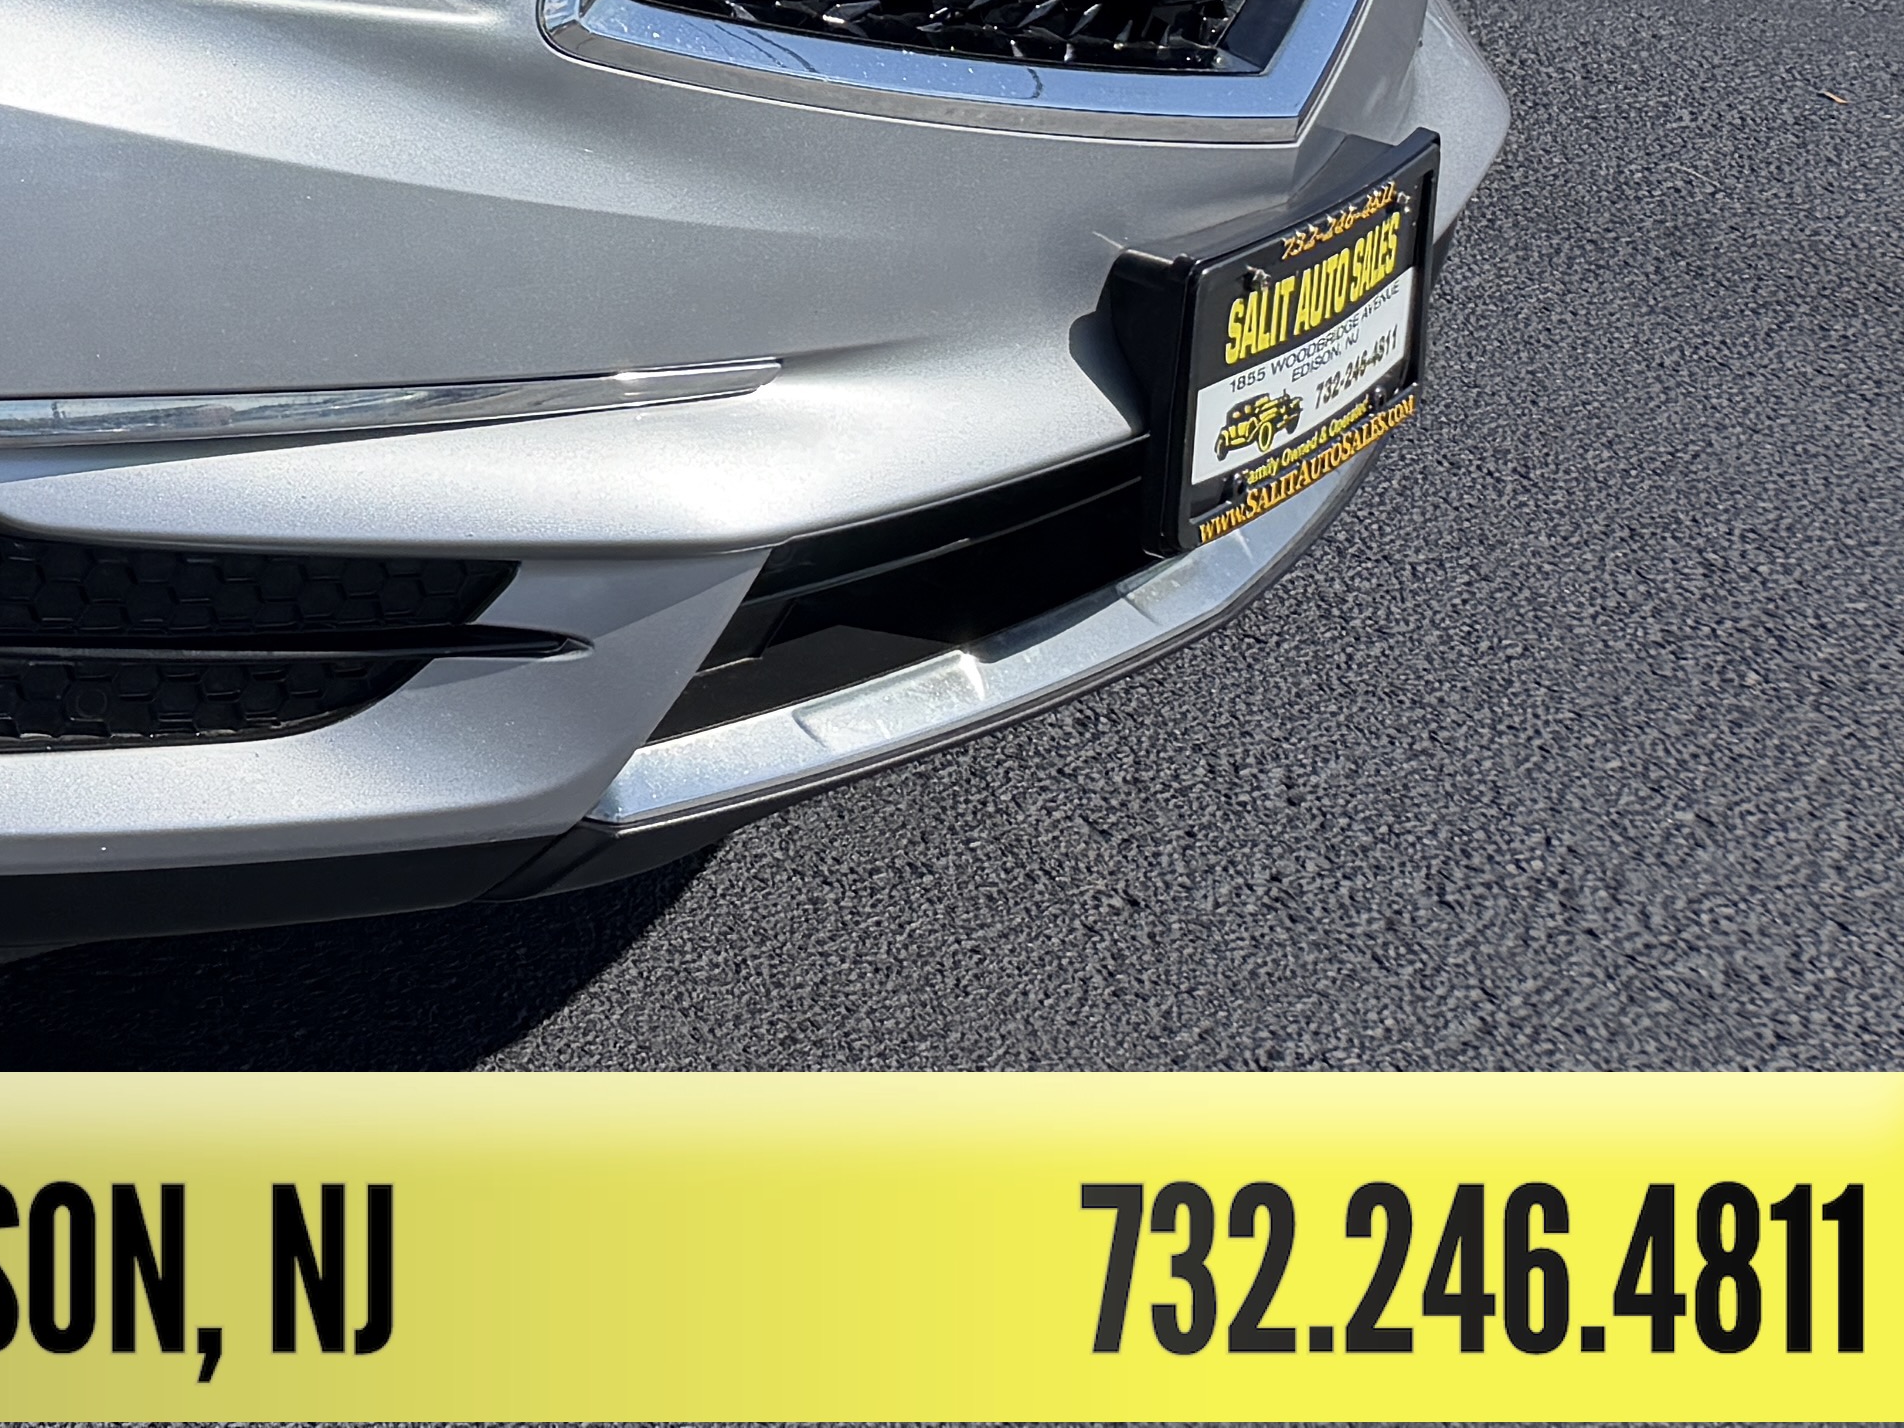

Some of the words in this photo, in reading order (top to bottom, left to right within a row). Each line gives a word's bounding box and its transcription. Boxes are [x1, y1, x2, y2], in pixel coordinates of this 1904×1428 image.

[1225, 275, 1297, 365] SALIT
[1293, 247, 1351, 336] AUTO
[1350, 212, 1401, 302] SALES
[1229, 366, 1267, 393] 1855
[1271, 314, 1360, 376] WOODBRIDGE
[1360, 279, 1401, 321] AVENUE
[1344, 327, 1360, 351] NJ
